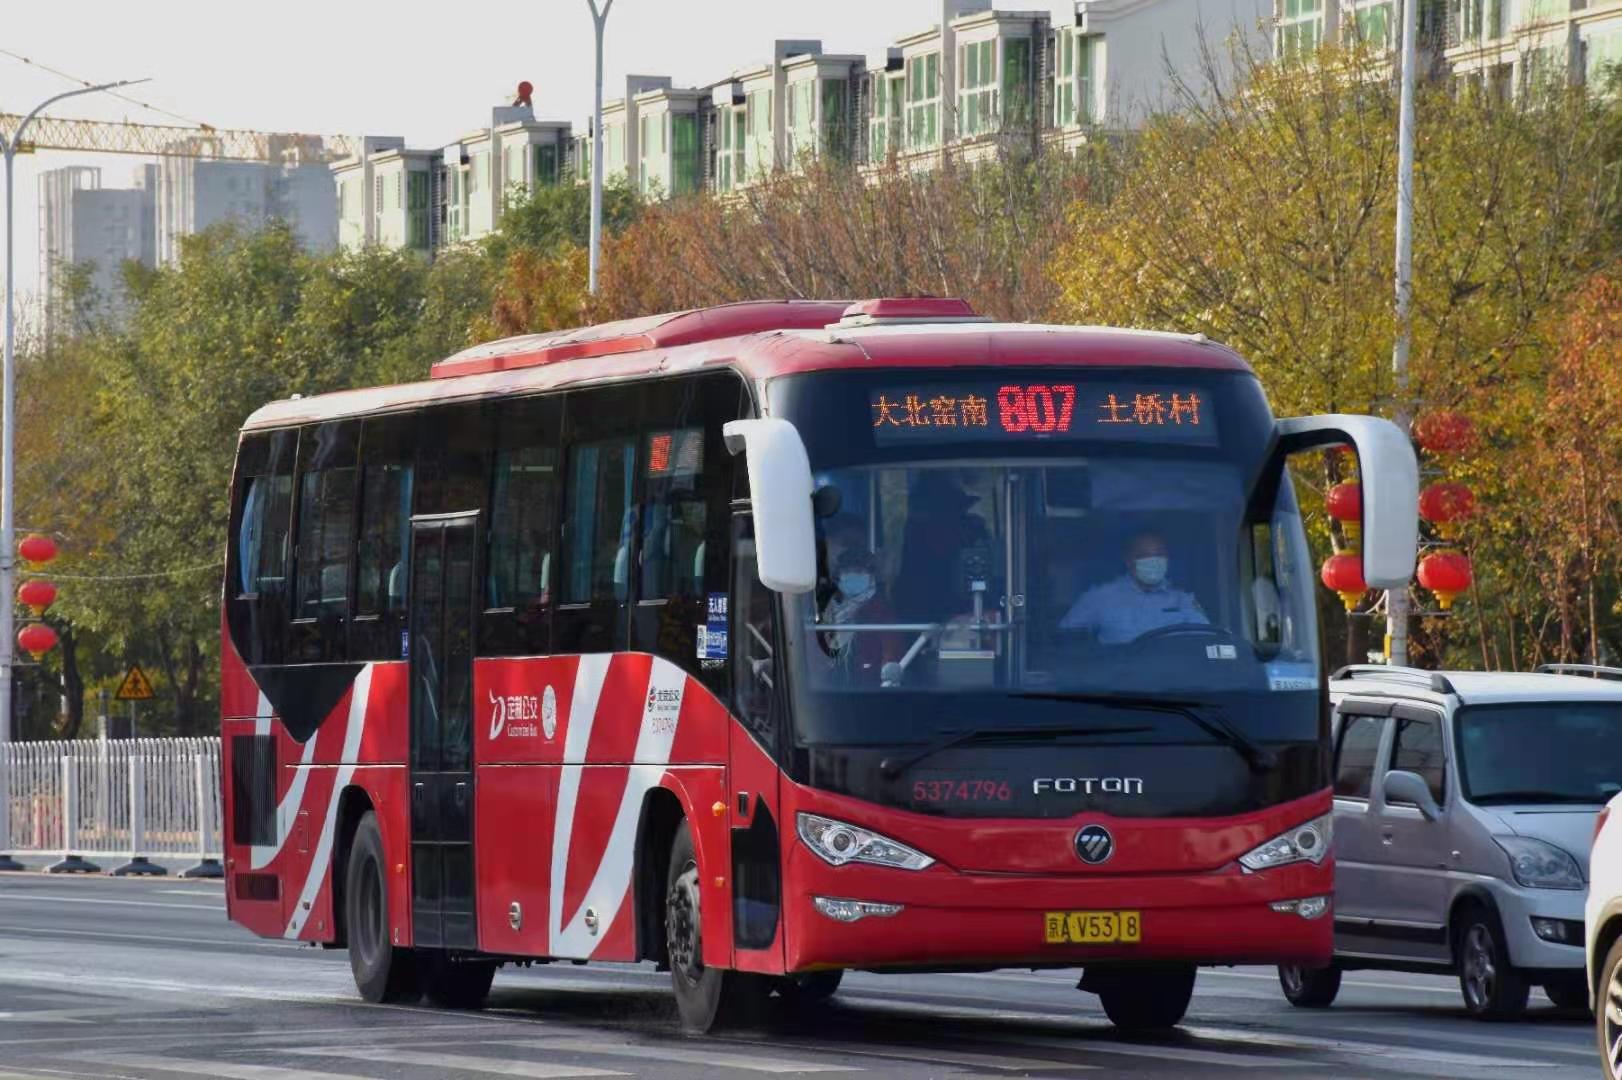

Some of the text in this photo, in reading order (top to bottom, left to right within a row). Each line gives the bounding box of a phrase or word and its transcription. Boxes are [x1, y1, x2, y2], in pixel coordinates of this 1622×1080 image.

[871, 384, 1200, 432] 大北窑南 807 土桥村
[507, 695, 538, 720] 定制公交
[912, 780, 1011, 801] 5374796
[1033, 777, 1143, 795] FOTON
